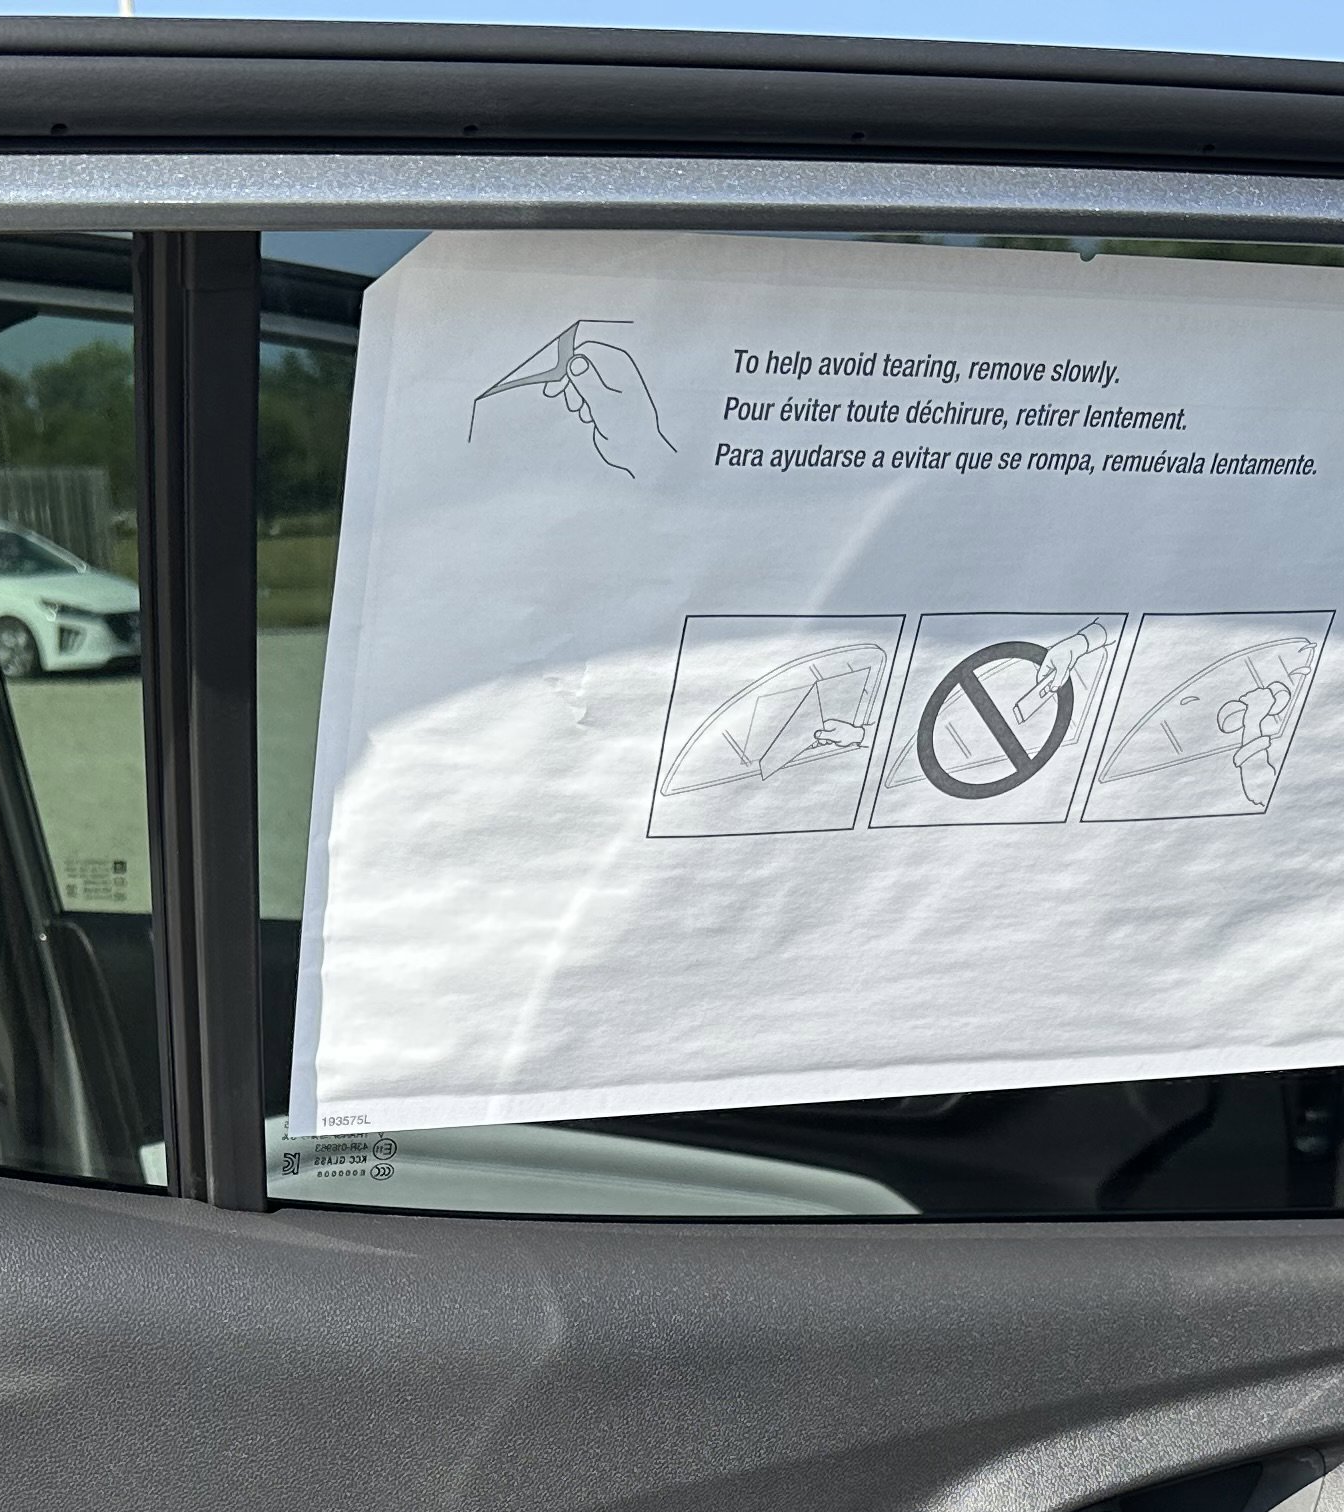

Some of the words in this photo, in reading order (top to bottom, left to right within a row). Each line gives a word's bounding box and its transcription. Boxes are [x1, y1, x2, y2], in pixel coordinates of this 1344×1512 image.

[733, 348, 760, 375] To
[765, 349, 813, 381] help
[818, 351, 878, 377] avoid
[882, 353, 961, 384] tearing,
[968, 361, 1046, 382] remove
[1050, 358, 1120, 389] slowly.
[723, 396, 776, 422] Pour
[779, 396, 842, 423] éviter
[846, 399, 900, 424] toute
[905, 398, 1009, 431] déchirure,
[1015, 404, 1081, 428] retirer
[1083, 404, 1187, 431] lentement.
[714, 442, 764, 467] Para
[769, 443, 867, 473] ayudarse
[871, 449, 886, 469] a
[891, 445, 952, 470] evitar
[955, 451, 993, 475] que
[997, 452, 1023, 471] se
[1026, 452, 1095, 476] rompa,
[1101, 449, 1206, 475] remuévala
[1209, 452, 1317, 476] lentamente.
[321, 1114, 371, 1127] 193575L
